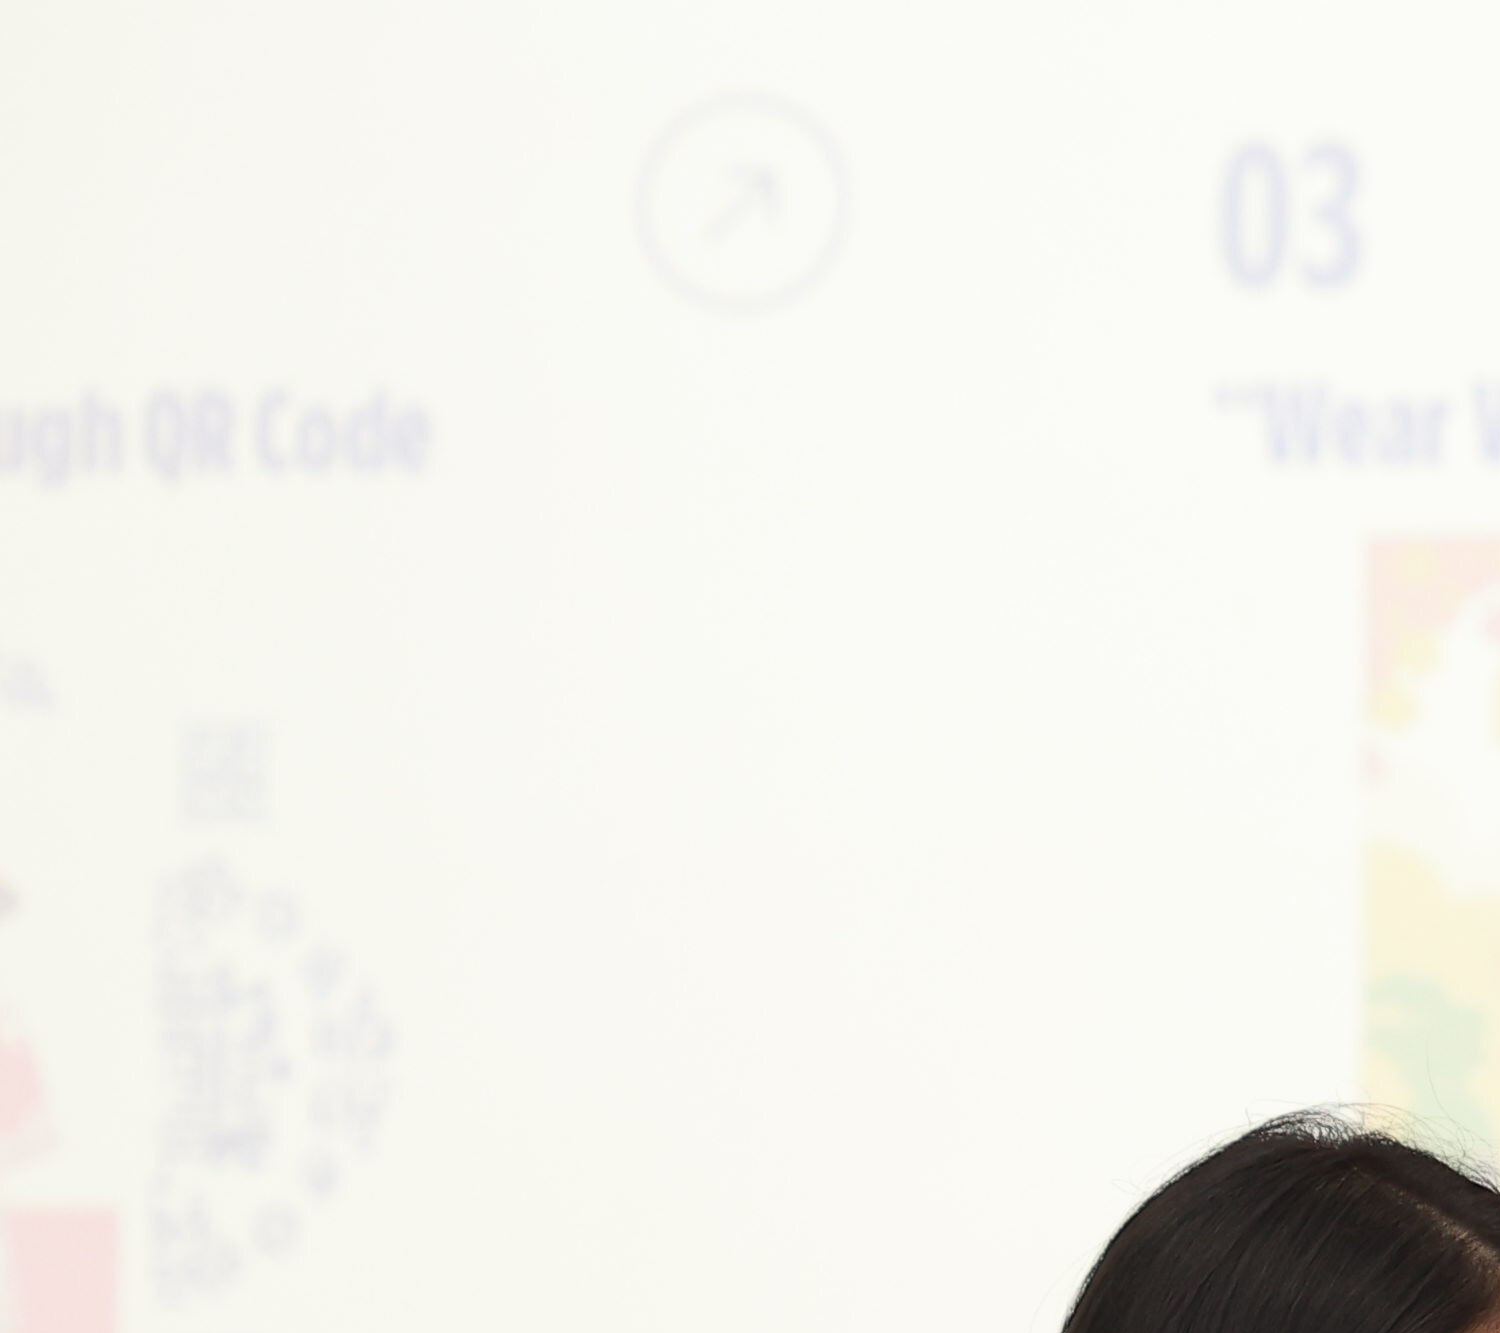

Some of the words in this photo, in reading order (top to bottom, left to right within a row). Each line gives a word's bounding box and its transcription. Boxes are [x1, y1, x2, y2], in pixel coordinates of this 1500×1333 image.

[1215, 136, 1367, 294] 03
[143, 385, 235, 488] QR
[253, 384, 435, 477] Code
